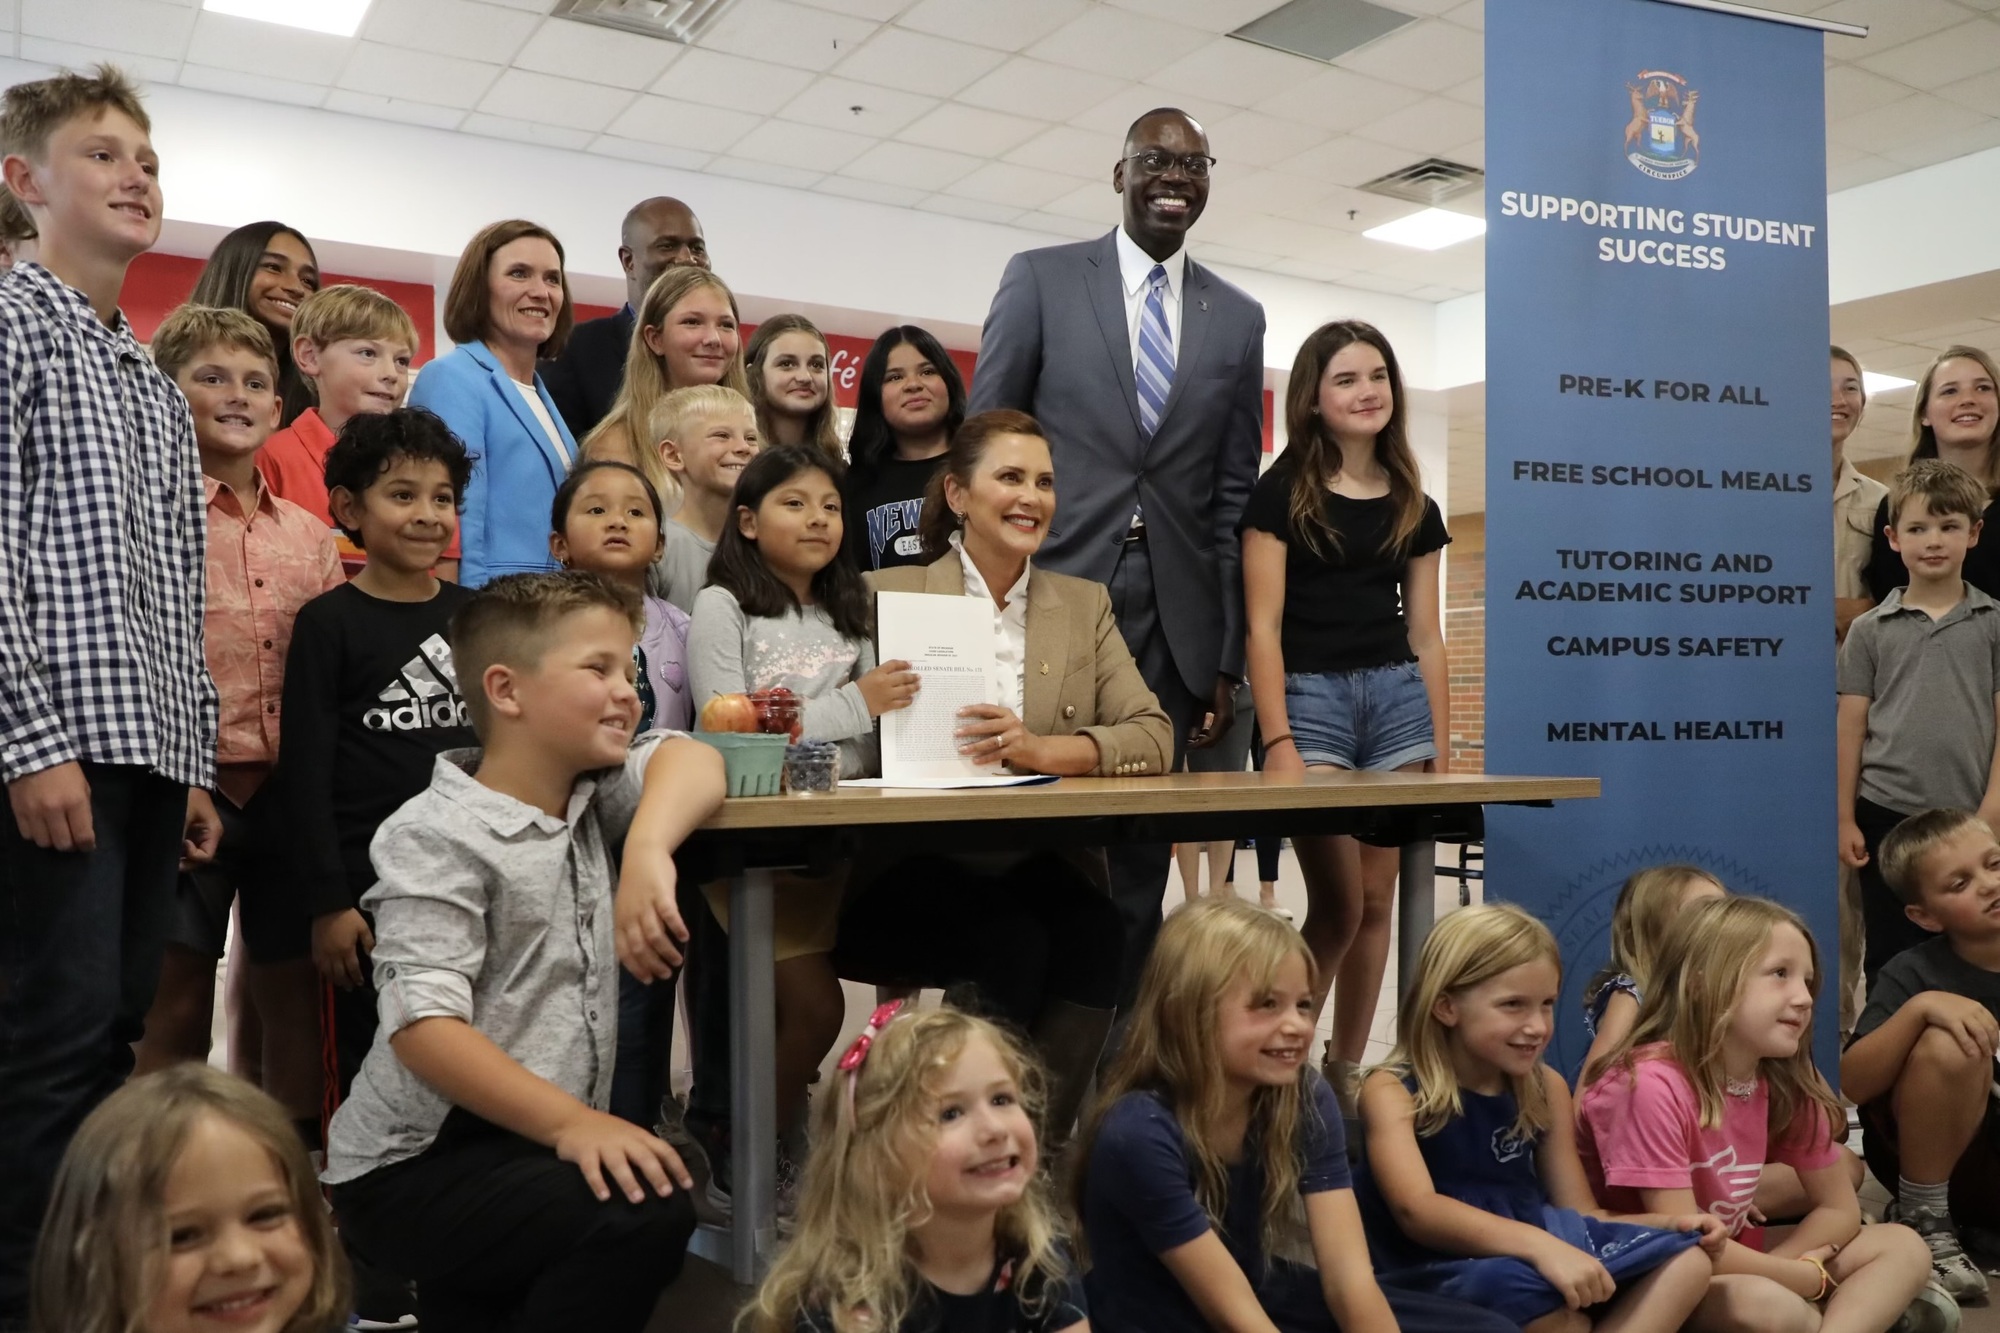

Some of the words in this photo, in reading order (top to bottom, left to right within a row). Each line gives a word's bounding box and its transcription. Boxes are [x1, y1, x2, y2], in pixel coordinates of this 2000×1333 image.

[1638, 164, 1688, 179] CIRCUMSPICE
[1501, 191, 1684, 234] SUPPORTING
[1692, 212, 1815, 248] STUDENT
[1599, 237, 1726, 271] SUCCESS
[829, 349, 861, 389] fé
[1559, 374, 1646, 399] PRE-K
[1654, 380, 1710, 403] FOR
[1718, 384, 1770, 407] ALL
[1513, 460, 1584, 483] FREE
[1591, 465, 1713, 489] SCHOOL
[1721, 470, 1813, 494] MEALS
[866, 497, 926, 570] NEW
[901, 539, 922, 552] EAS
[1556, 549, 1702, 573] TUTORING
[1710, 553, 1773, 574] AND
[1515, 580, 1672, 603] ACADEMIC
[1679, 583, 1812, 605] SUPPORT
[1547, 635, 1671, 657] CAMPUS
[1677, 637, 1784, 657] SAFETY
[362, 692, 473, 732] adida
[1547, 721, 1666, 742] MENTAL
[1674, 720, 1783, 741] HEALTH
